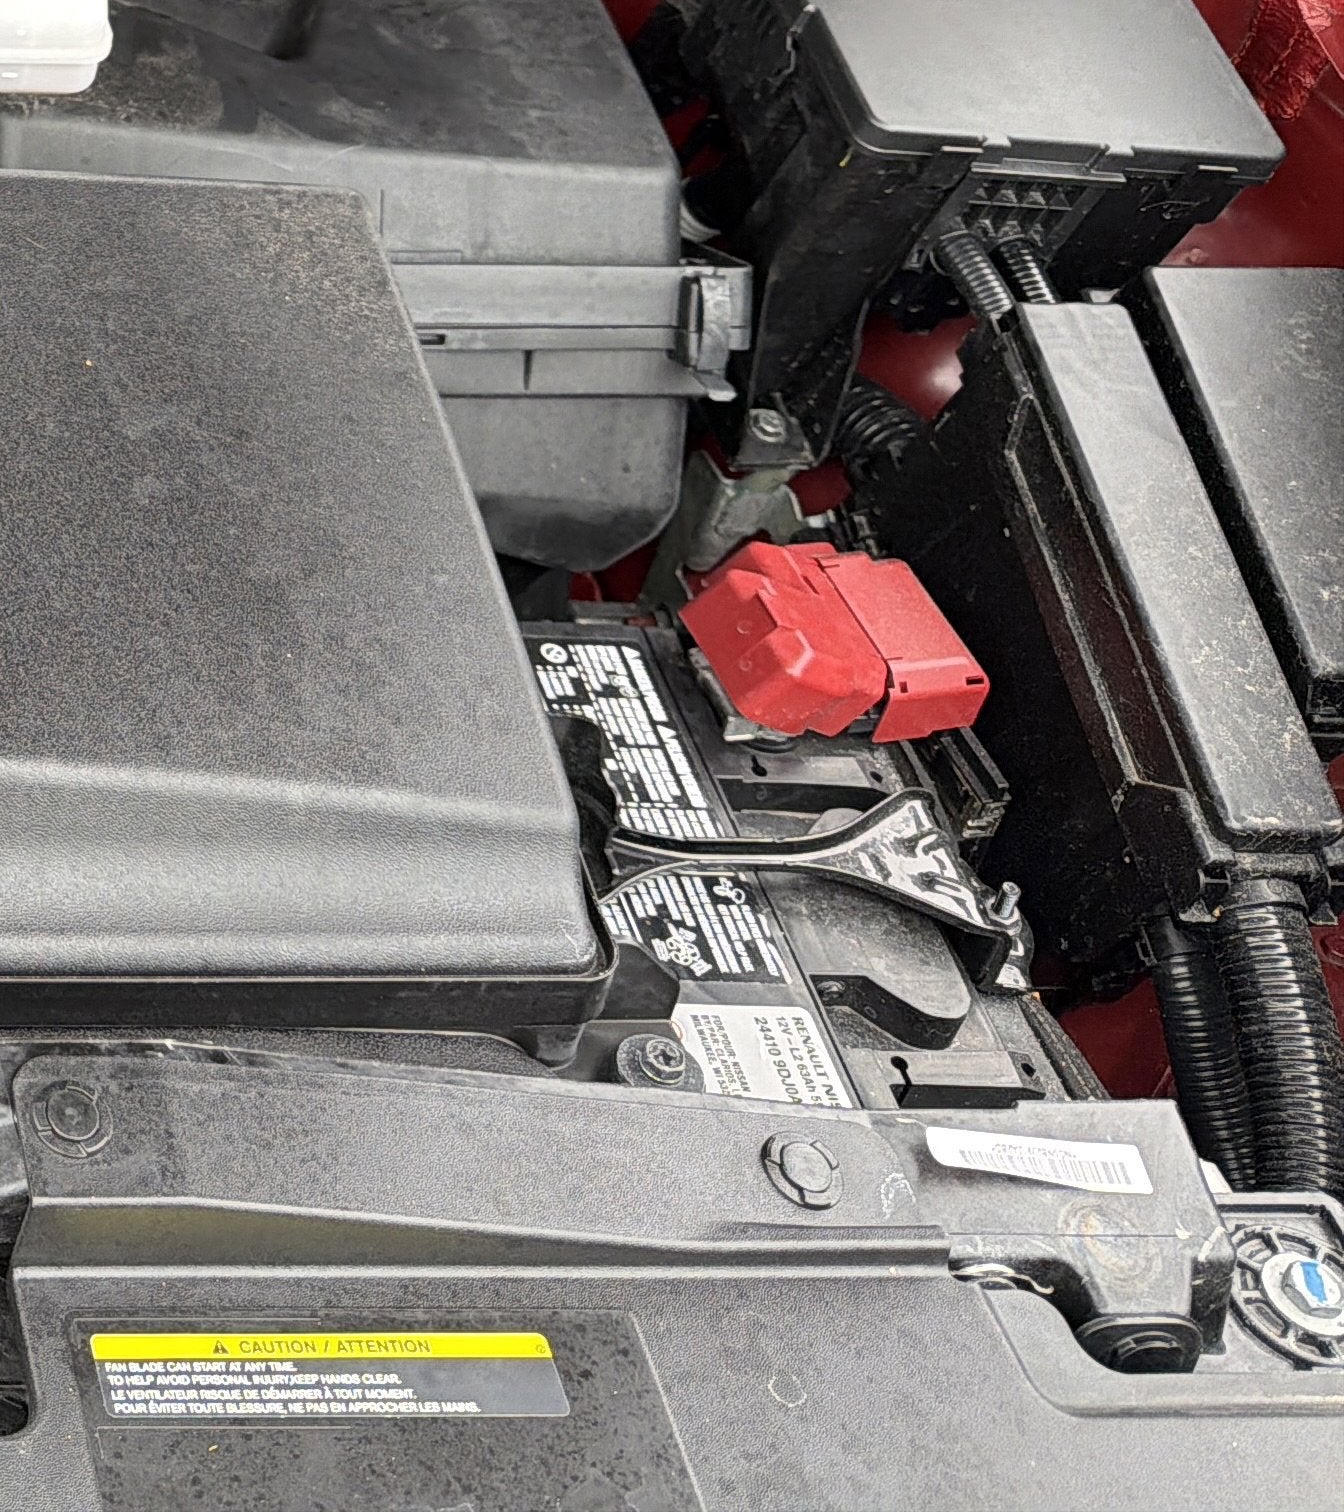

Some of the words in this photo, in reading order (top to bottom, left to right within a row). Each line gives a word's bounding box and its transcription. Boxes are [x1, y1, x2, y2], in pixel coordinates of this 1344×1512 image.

[776, 1016, 793, 1036] 12V
[753, 1016, 781, 1057] 24410
[789, 1047, 804, 1062] L2
[792, 1016, 829, 1081] RENAULT
[731, 1061, 751, 1093] NISSAN
[796, 1063, 817, 1093] 63Ah
[239, 1340, 317, 1353] CAUTION
[337, 1340, 431, 1354] ATTENTION
[104, 1361, 127, 1372] FAN
[128, 1361, 165, 1372] BLADE
[166, 1361, 191, 1372] CAN
[193, 1361, 226, 1372] START
[229, 1361, 242, 1372] AT
[244, 1361, 267, 1372] ANY
[107, 1374, 123, 1385] TO
[125, 1374, 154, 1385] HELP
[156, 1374, 190, 1385] AVOID
[191, 1374, 251, 1385] PERSONAL
[319, 1374, 361, 1385] HANDS
[111, 1389, 126, 1400] LE
[126, 1389, 199, 1400] VENTILATEUR
[199, 1389, 243, 1400] RISQUE
[243, 1389, 259, 1400] DE
[333, 1389, 363, 1400] TOUT
[113, 1402, 148, 1414] POUR
[148, 1400, 187, 1414] ÉVITER
[187, 1402, 225, 1414] TOUTE
[287, 1402, 305, 1413] NE
[305, 1402, 329, 1413] PAS
[329, 1402, 347, 1413] EN
[348, 1401, 419, 1413] APPROCHER
[419, 1402, 440, 1413] LES
